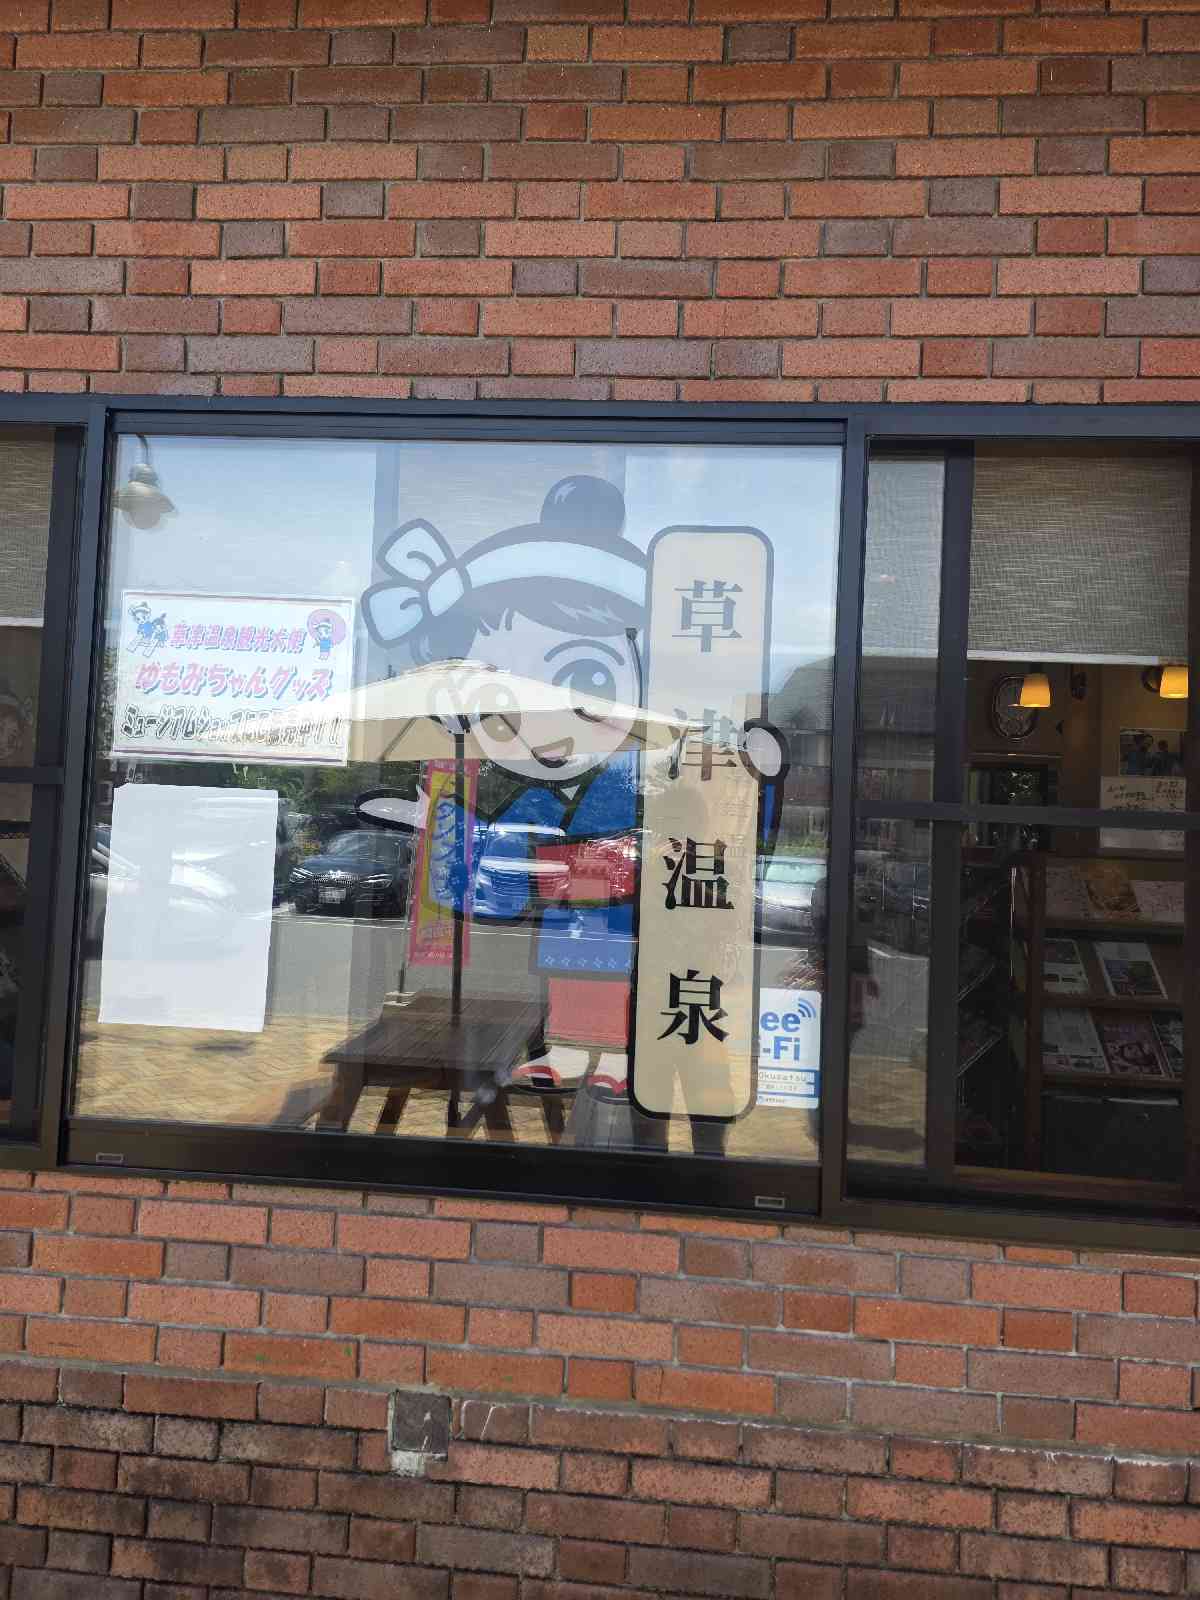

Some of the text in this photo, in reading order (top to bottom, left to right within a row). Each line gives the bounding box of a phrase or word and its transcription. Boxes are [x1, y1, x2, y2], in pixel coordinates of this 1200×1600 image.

[657, 579, 743, 1044] 草津温泉
[759, 1012, 800, 1033] ee
[762, 1036, 801, 1061] -Fi
